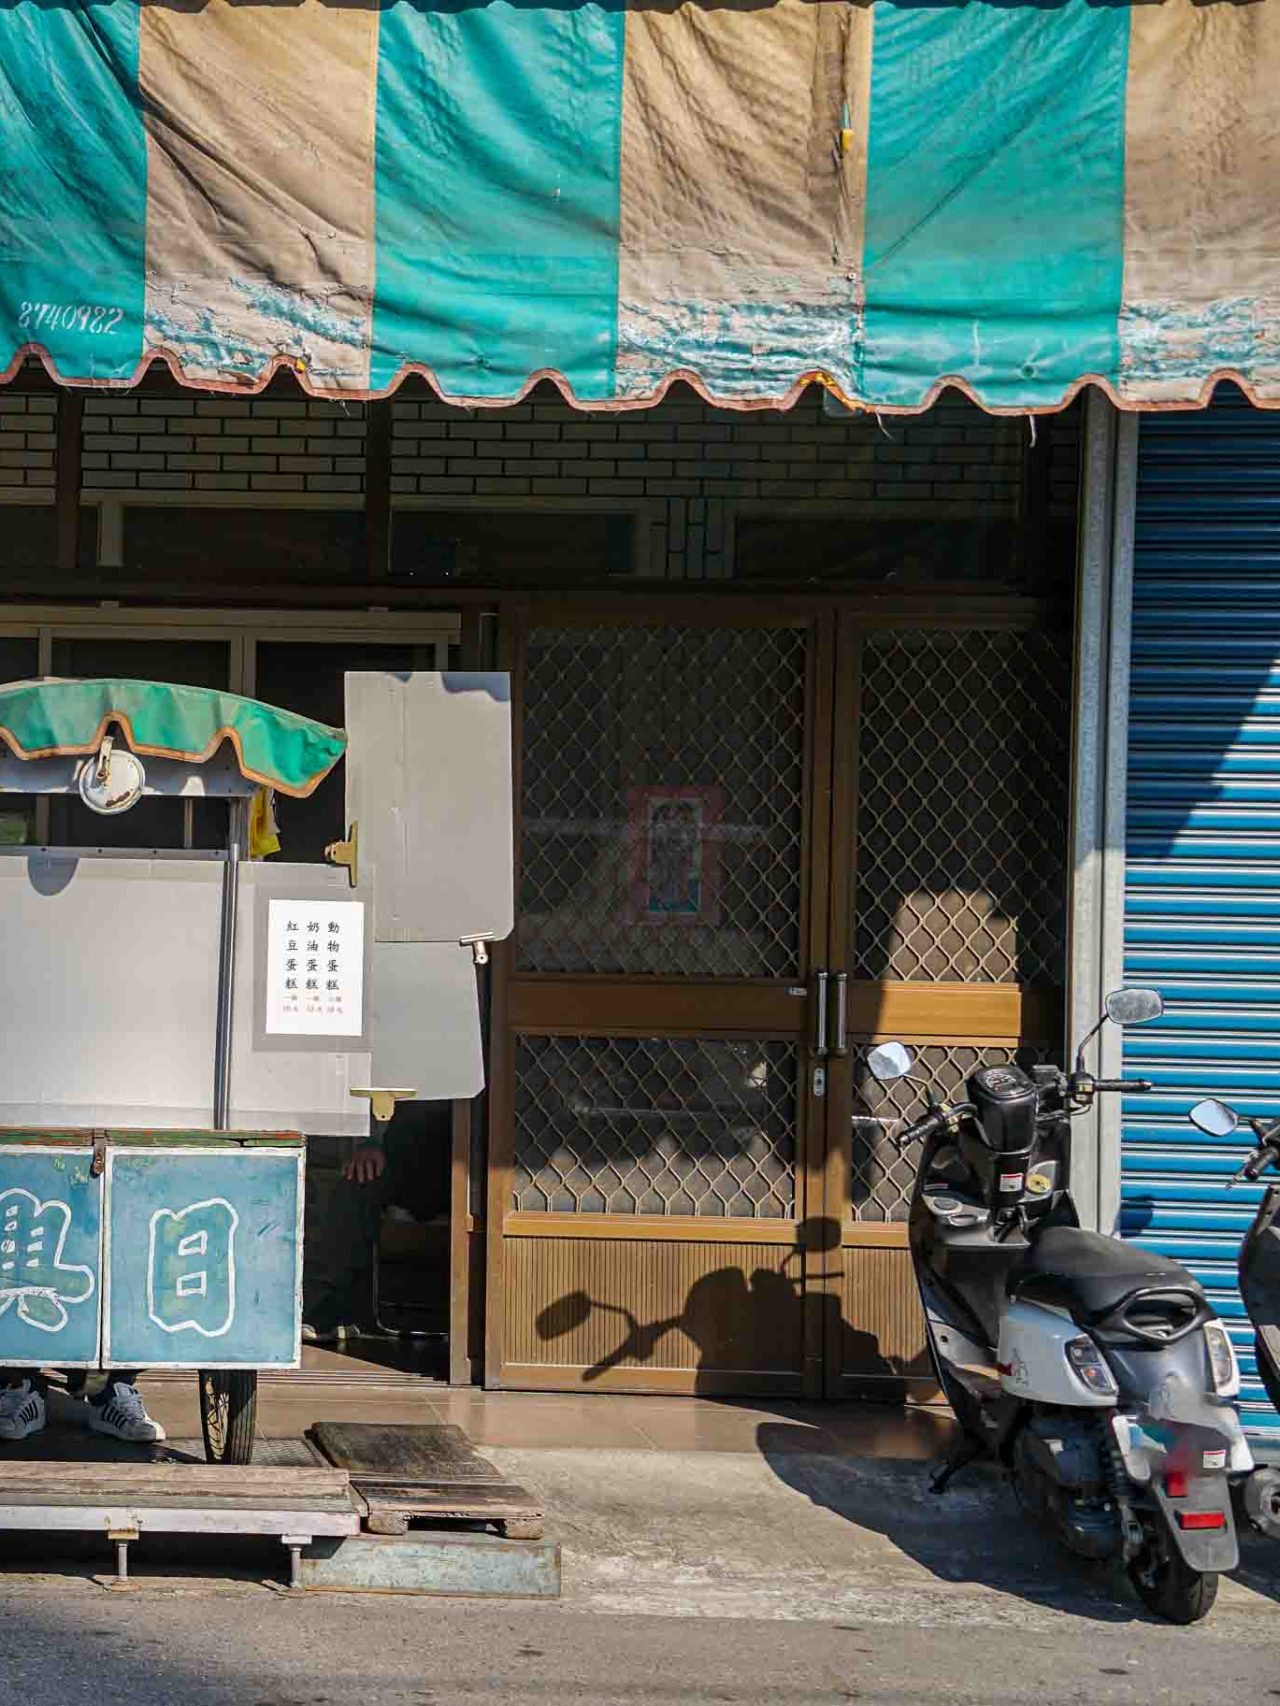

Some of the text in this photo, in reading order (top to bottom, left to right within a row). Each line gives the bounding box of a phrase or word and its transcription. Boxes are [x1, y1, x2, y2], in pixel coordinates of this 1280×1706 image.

[285, 920, 299, 989] 紅豆蛋糕
[305, 921, 320, 990] 奶油蛋糕
[325, 921, 340, 990] 動物蛋糕
